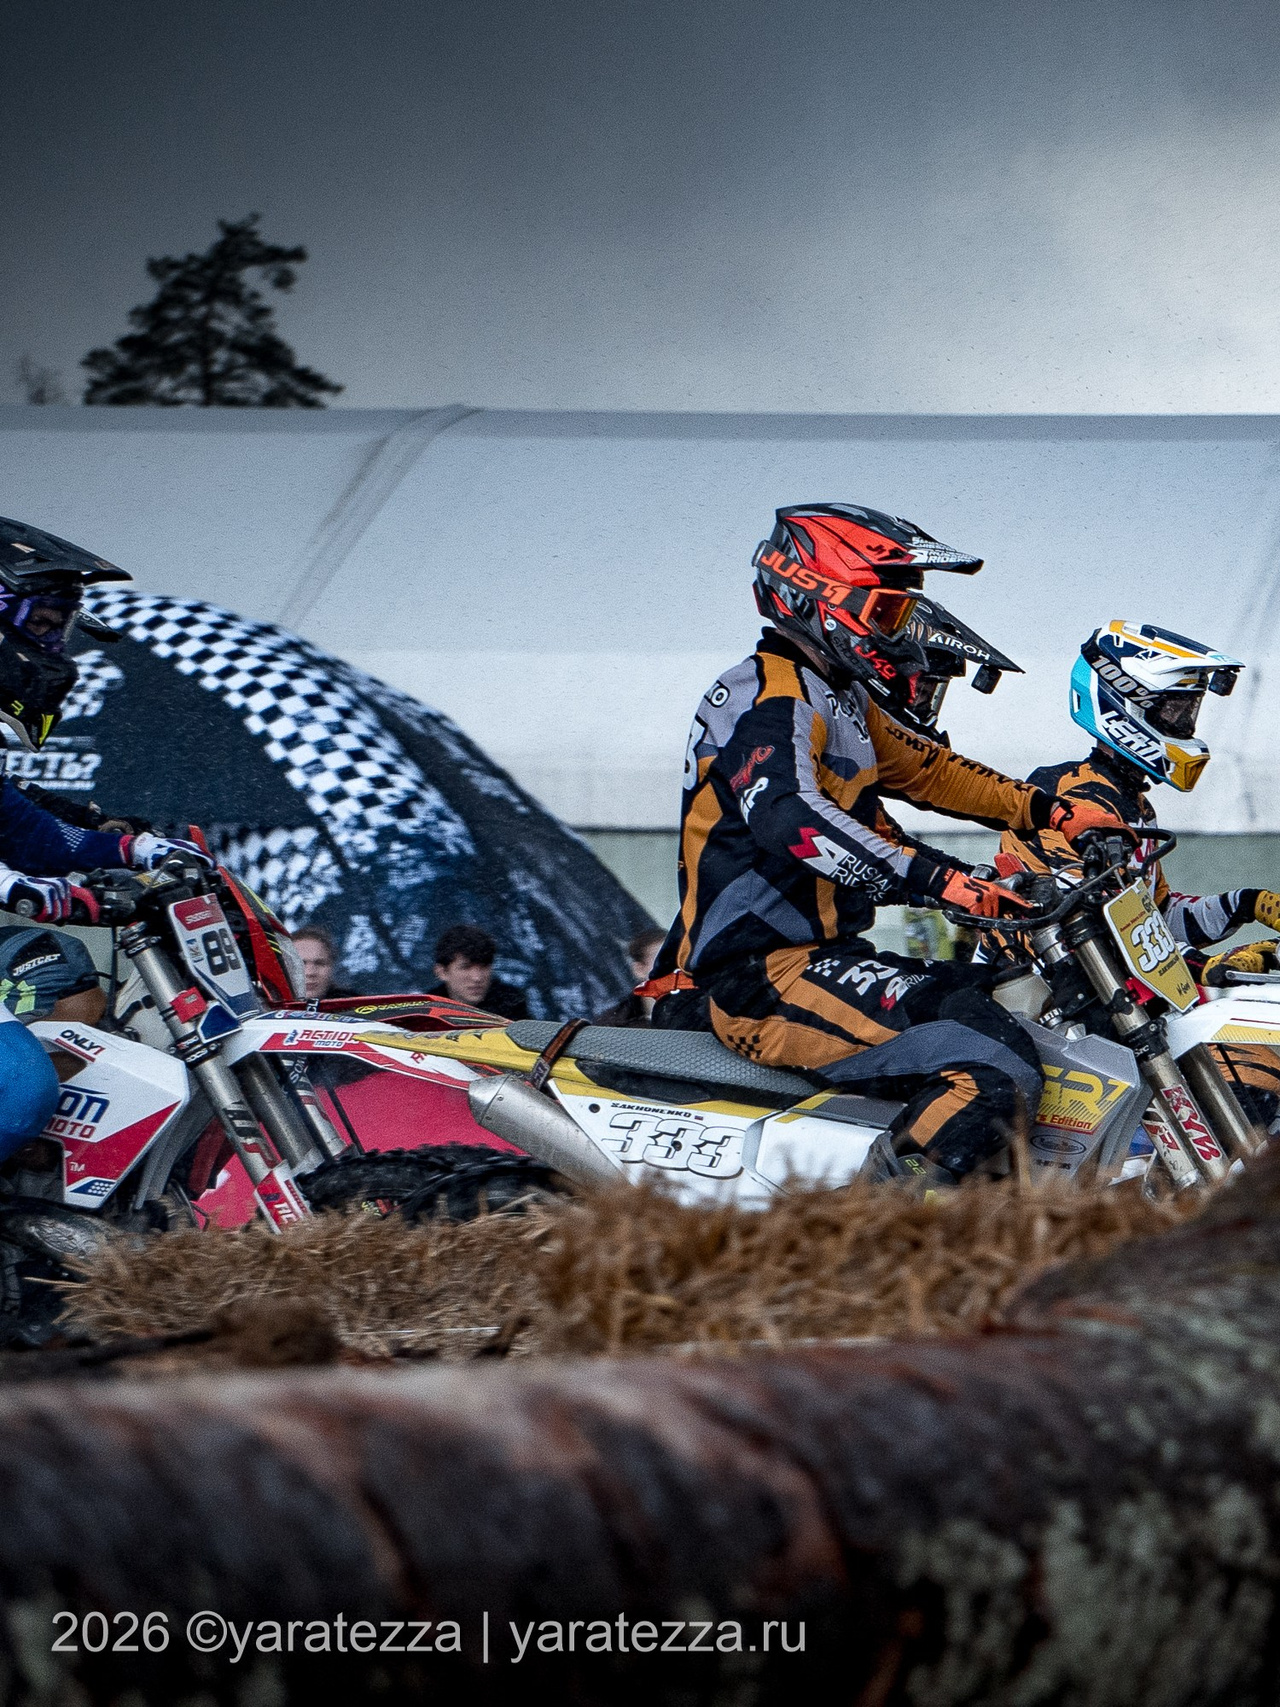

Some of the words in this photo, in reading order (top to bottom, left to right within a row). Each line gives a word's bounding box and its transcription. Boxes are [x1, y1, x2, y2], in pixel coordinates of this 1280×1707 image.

[761, 550, 853, 605] JUST1
[928, 632, 990, 660] AIROH
[1091, 655, 1160, 708] 100%
[600, 1111, 747, 1180] 333
[1049, 1114, 1093, 1130] Edition
[1160, 1084, 1223, 1161] KYB
